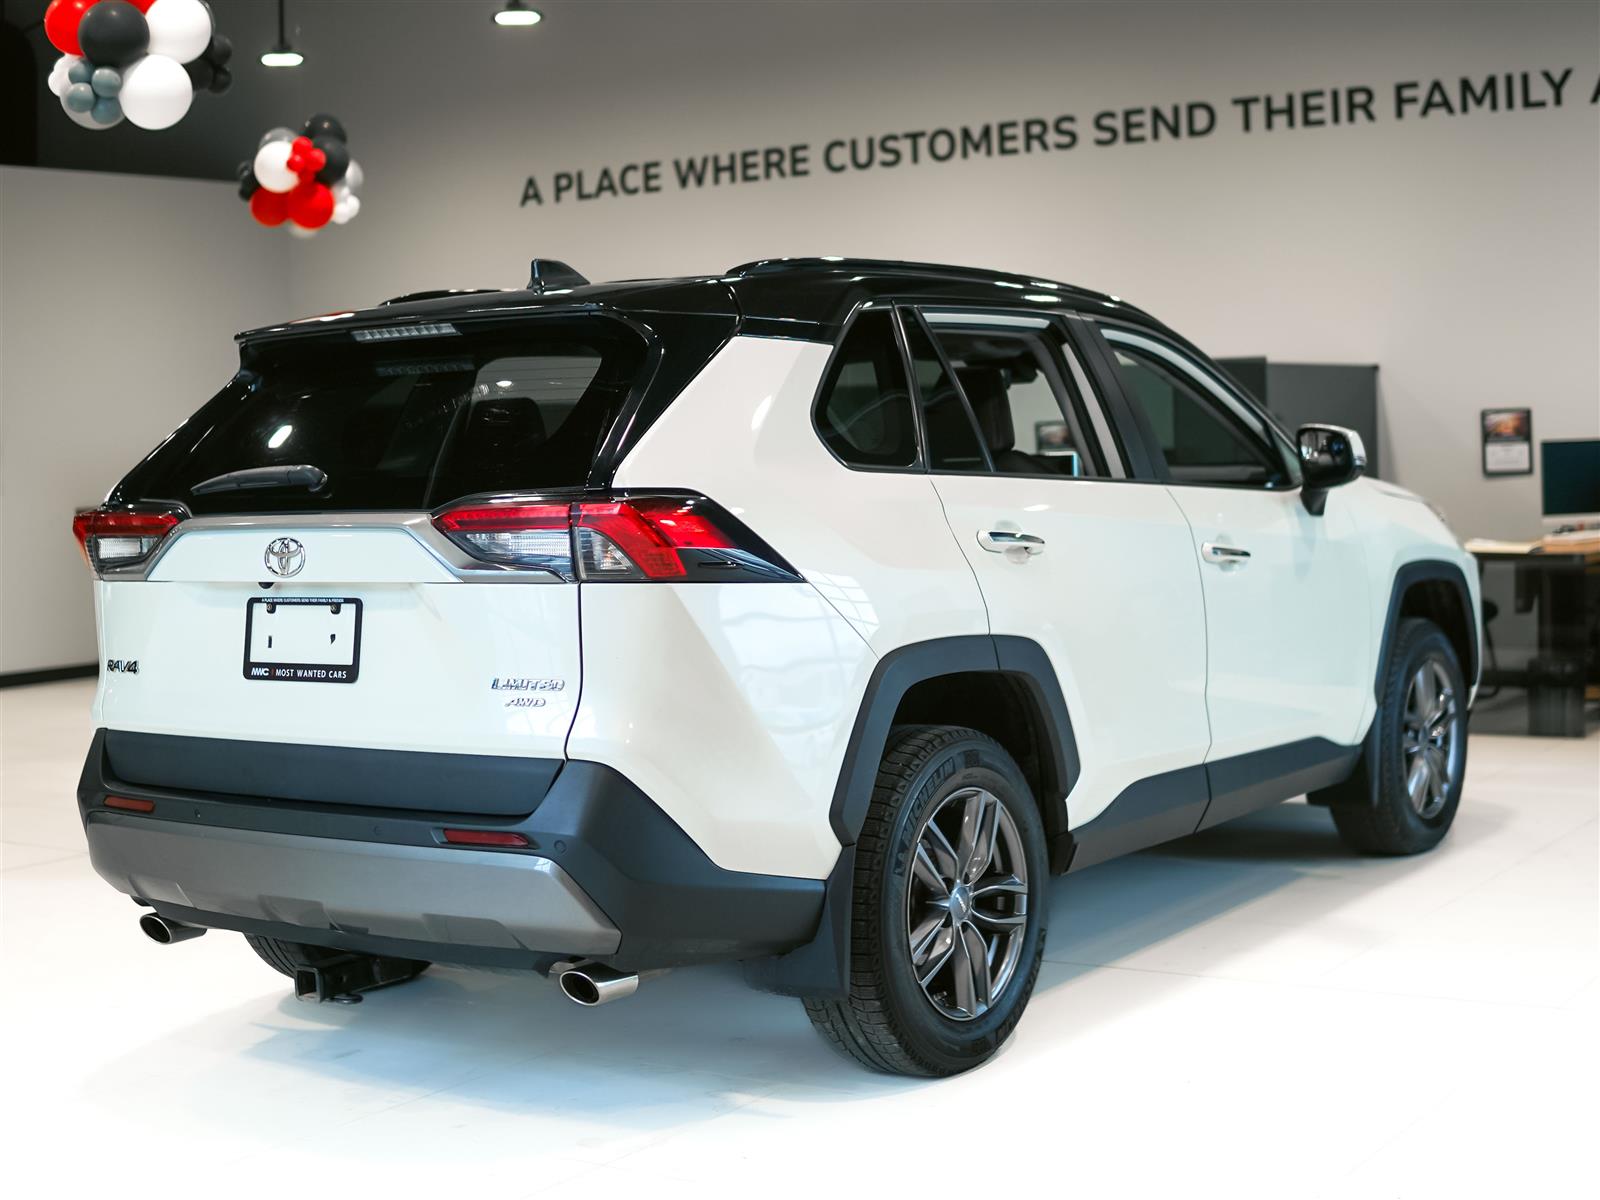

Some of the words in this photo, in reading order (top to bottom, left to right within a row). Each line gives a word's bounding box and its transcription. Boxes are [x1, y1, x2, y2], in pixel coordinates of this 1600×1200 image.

[520, 176, 545, 208] A
[554, 160, 663, 204] PLACE
[673, 143, 811, 190] WHERE
[824, 114, 1079, 174] CUSTOMERS
[1093, 101, 1217, 148] SEND
[1231, 85, 1377, 134] THEIR
[1394, 67, 1574, 121] FAMILY
[107, 659, 139, 674] RAV4
[275, 668, 294, 677] MOST
[297, 669, 326, 678] WANTED
[328, 670, 347, 679] CARS
[491, 678, 565, 691] LIMITED
[505, 698, 546, 707] AWD
[900, 756, 956, 847] MICHELIN
